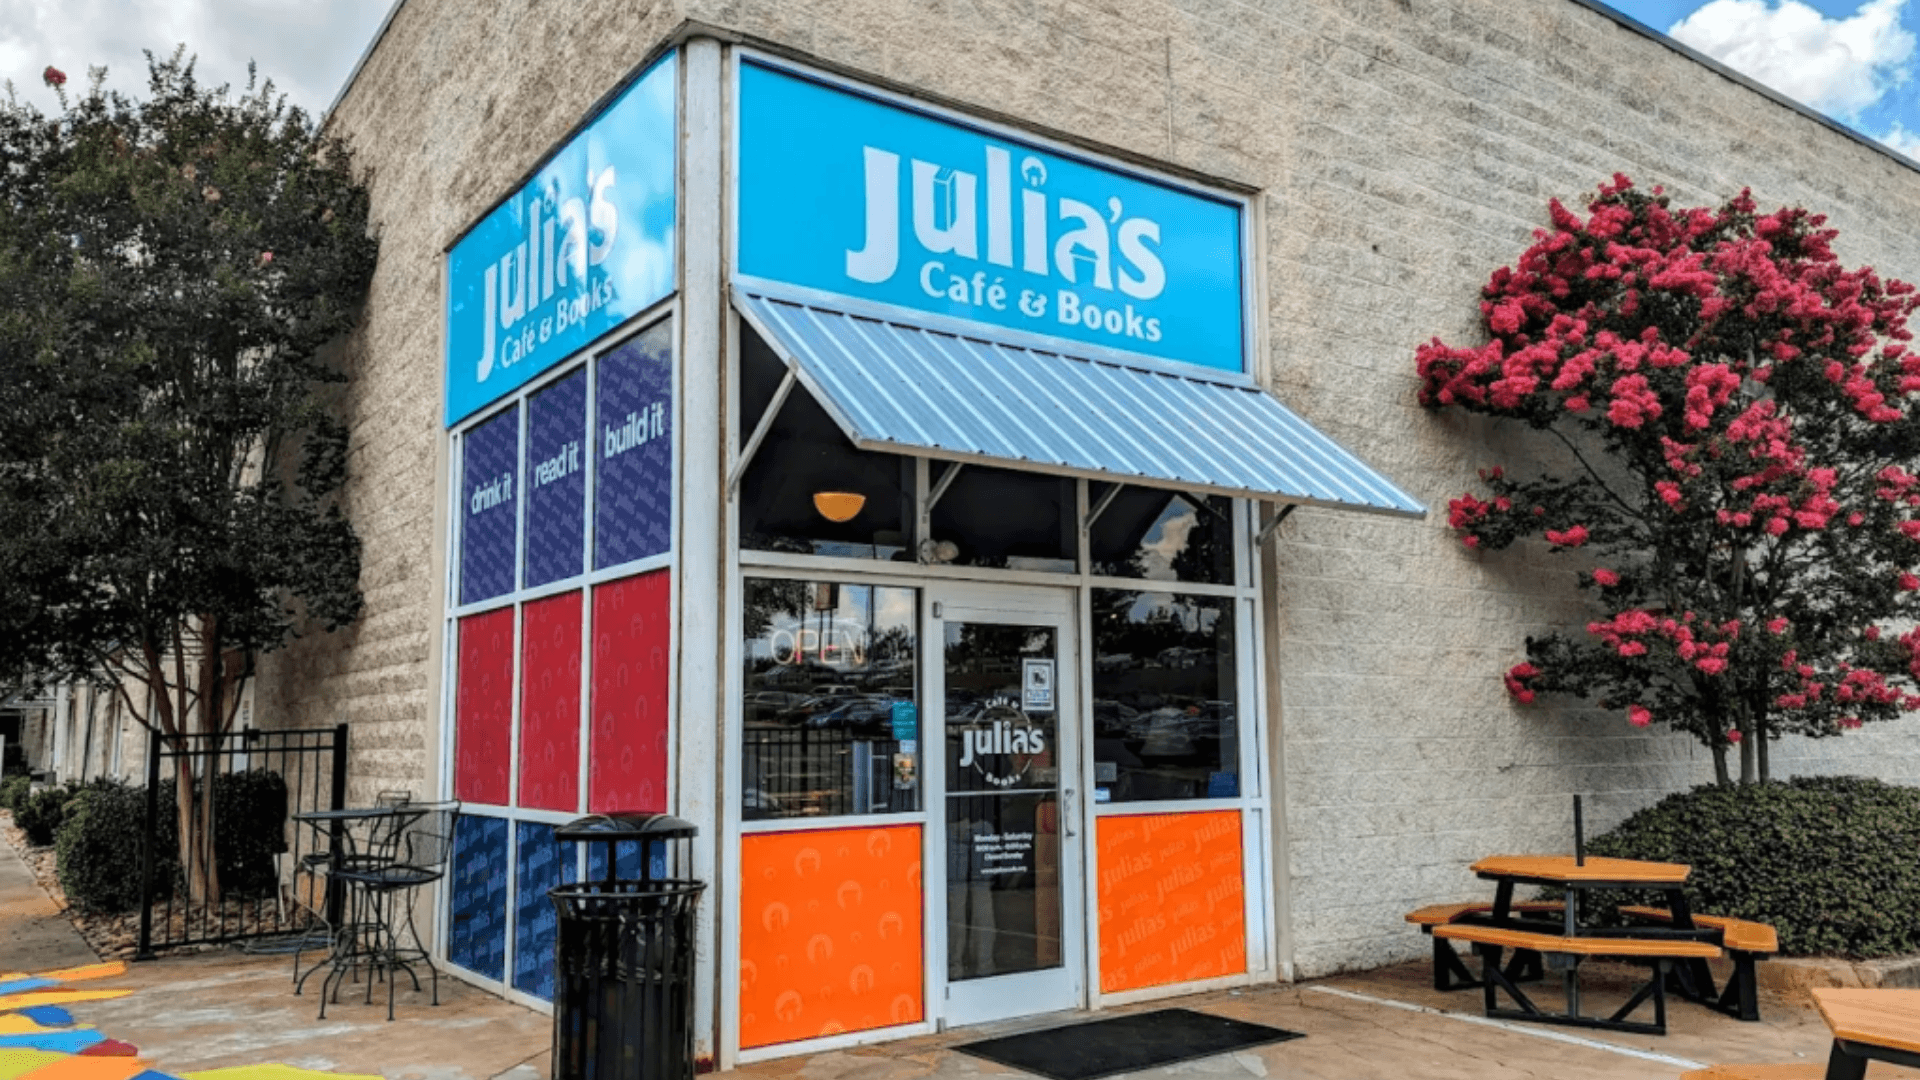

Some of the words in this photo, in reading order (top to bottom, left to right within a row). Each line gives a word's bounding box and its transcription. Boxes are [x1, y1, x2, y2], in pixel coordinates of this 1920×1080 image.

[845, 144, 1167, 301] Julia's
[476, 164, 620, 383] Julia's
[919, 260, 1007, 311] Café
[1018, 289, 1048, 318] &
[1057, 289, 1162, 343] Books
[501, 321, 537, 369] Café
[539, 316, 553, 343] &
[556, 274, 614, 335] Books
[534, 443, 568, 488] read
[569, 440, 579, 473] it
[604, 406, 649, 459] build
[651, 401, 665, 440] it
[471, 475, 501, 515] drink
[502, 472, 512, 502] it
[771, 628, 864, 666] OPEN
